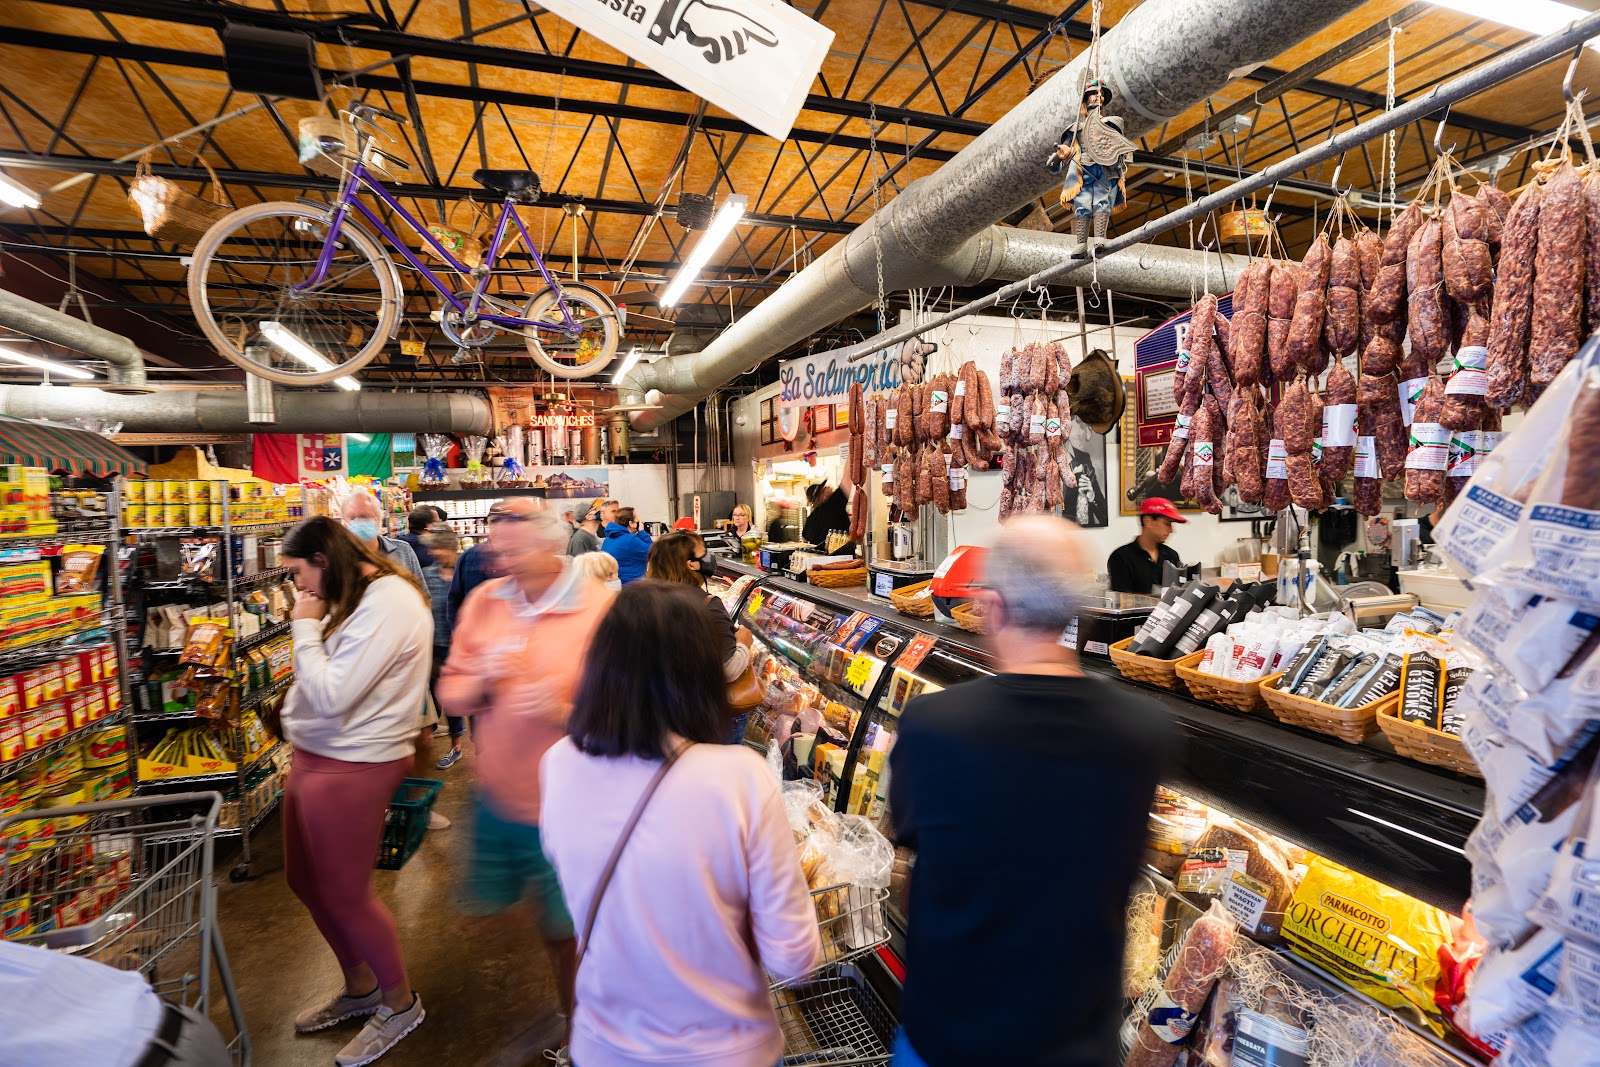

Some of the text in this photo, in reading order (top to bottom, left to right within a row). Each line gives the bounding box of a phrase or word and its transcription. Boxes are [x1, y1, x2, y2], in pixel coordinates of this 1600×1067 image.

[597, 0, 647, 24] sta
[780, 366, 801, 401] La
[529, 415, 595, 427] SANDWICHES
[1357, 670, 1400, 707] UNIPER
[1404, 669, 1422, 716] SMOKED
[1418, 669, 1435, 720] PAPRIKA
[1228, 897, 1244, 909] ROAST
[1233, 892, 1256, 908] WAGYU
[1324, 895, 1386, 930] PARMACOTTO
[1311, 932, 1354, 959] SEASONED
